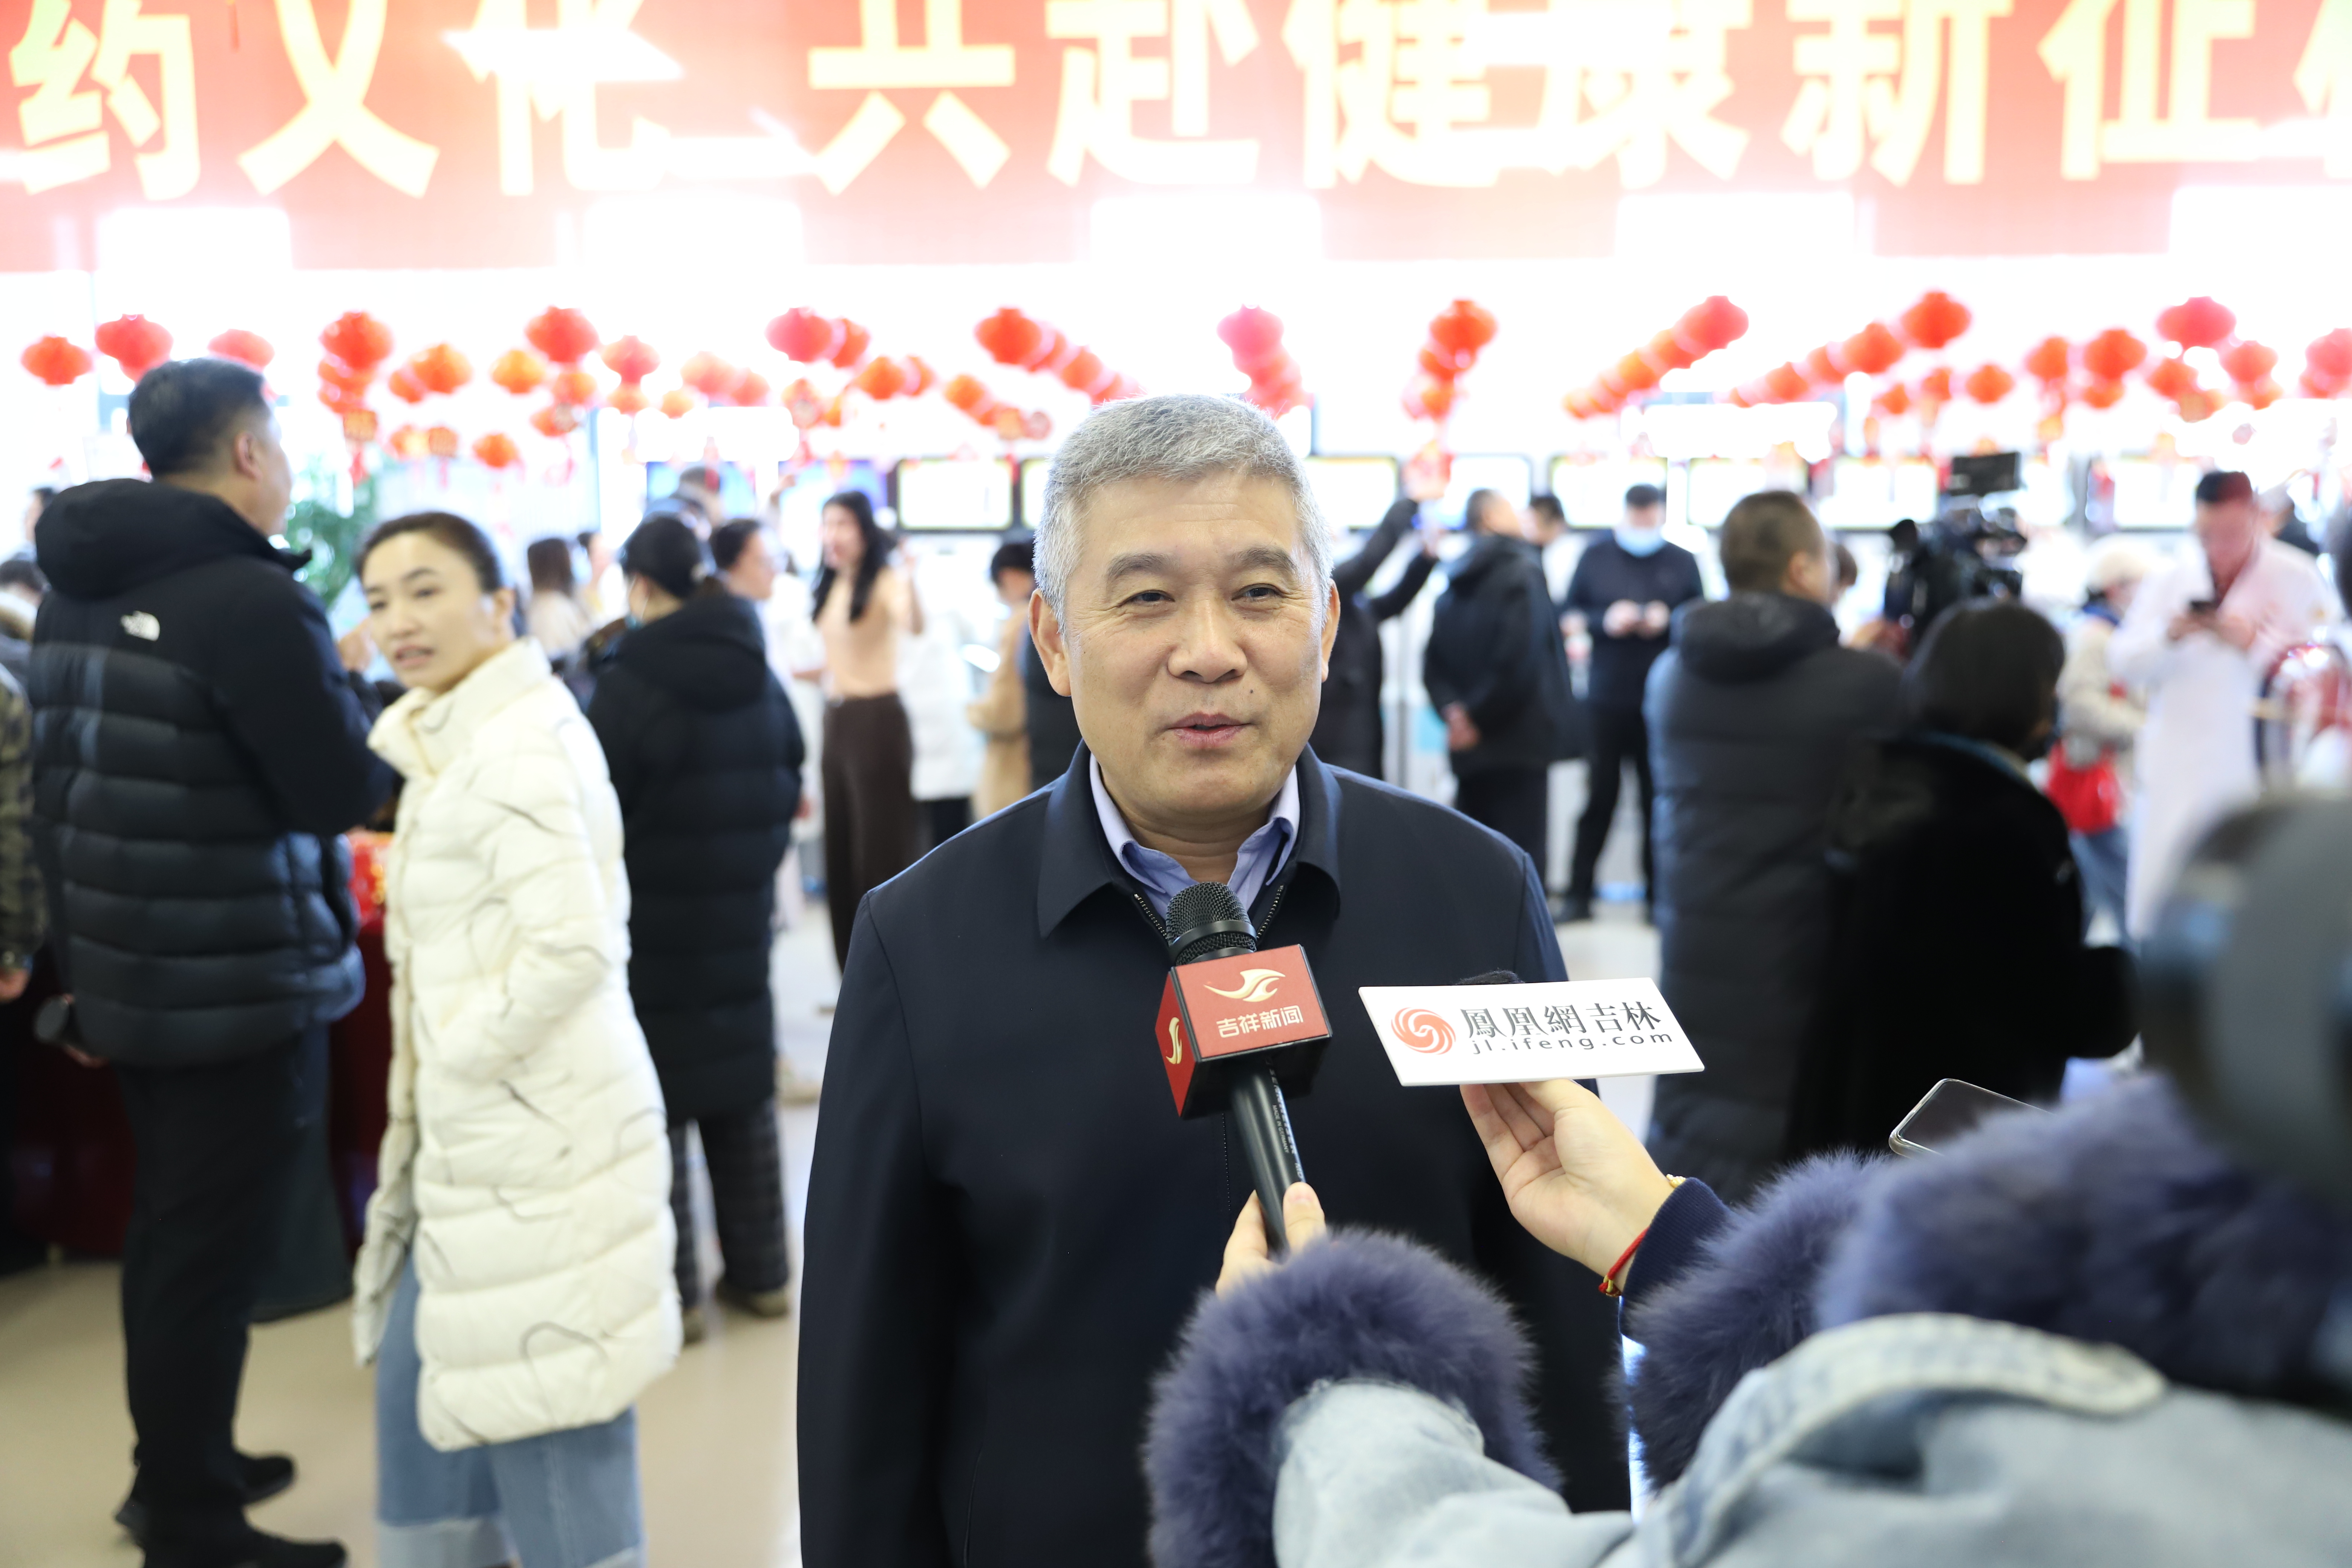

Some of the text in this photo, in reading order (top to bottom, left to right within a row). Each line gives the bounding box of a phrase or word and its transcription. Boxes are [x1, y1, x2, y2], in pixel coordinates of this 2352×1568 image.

[1216, 1005, 1304, 1038] 吉祥新闻
[1460, 1001, 1661, 1038] 鳳凰網吉林
[1472, 1034, 1672, 1055] jl.ifeng.com
[1272, 1104, 1281, 1121] MADE
[1278, 1127, 1289, 1153] GERMANY
